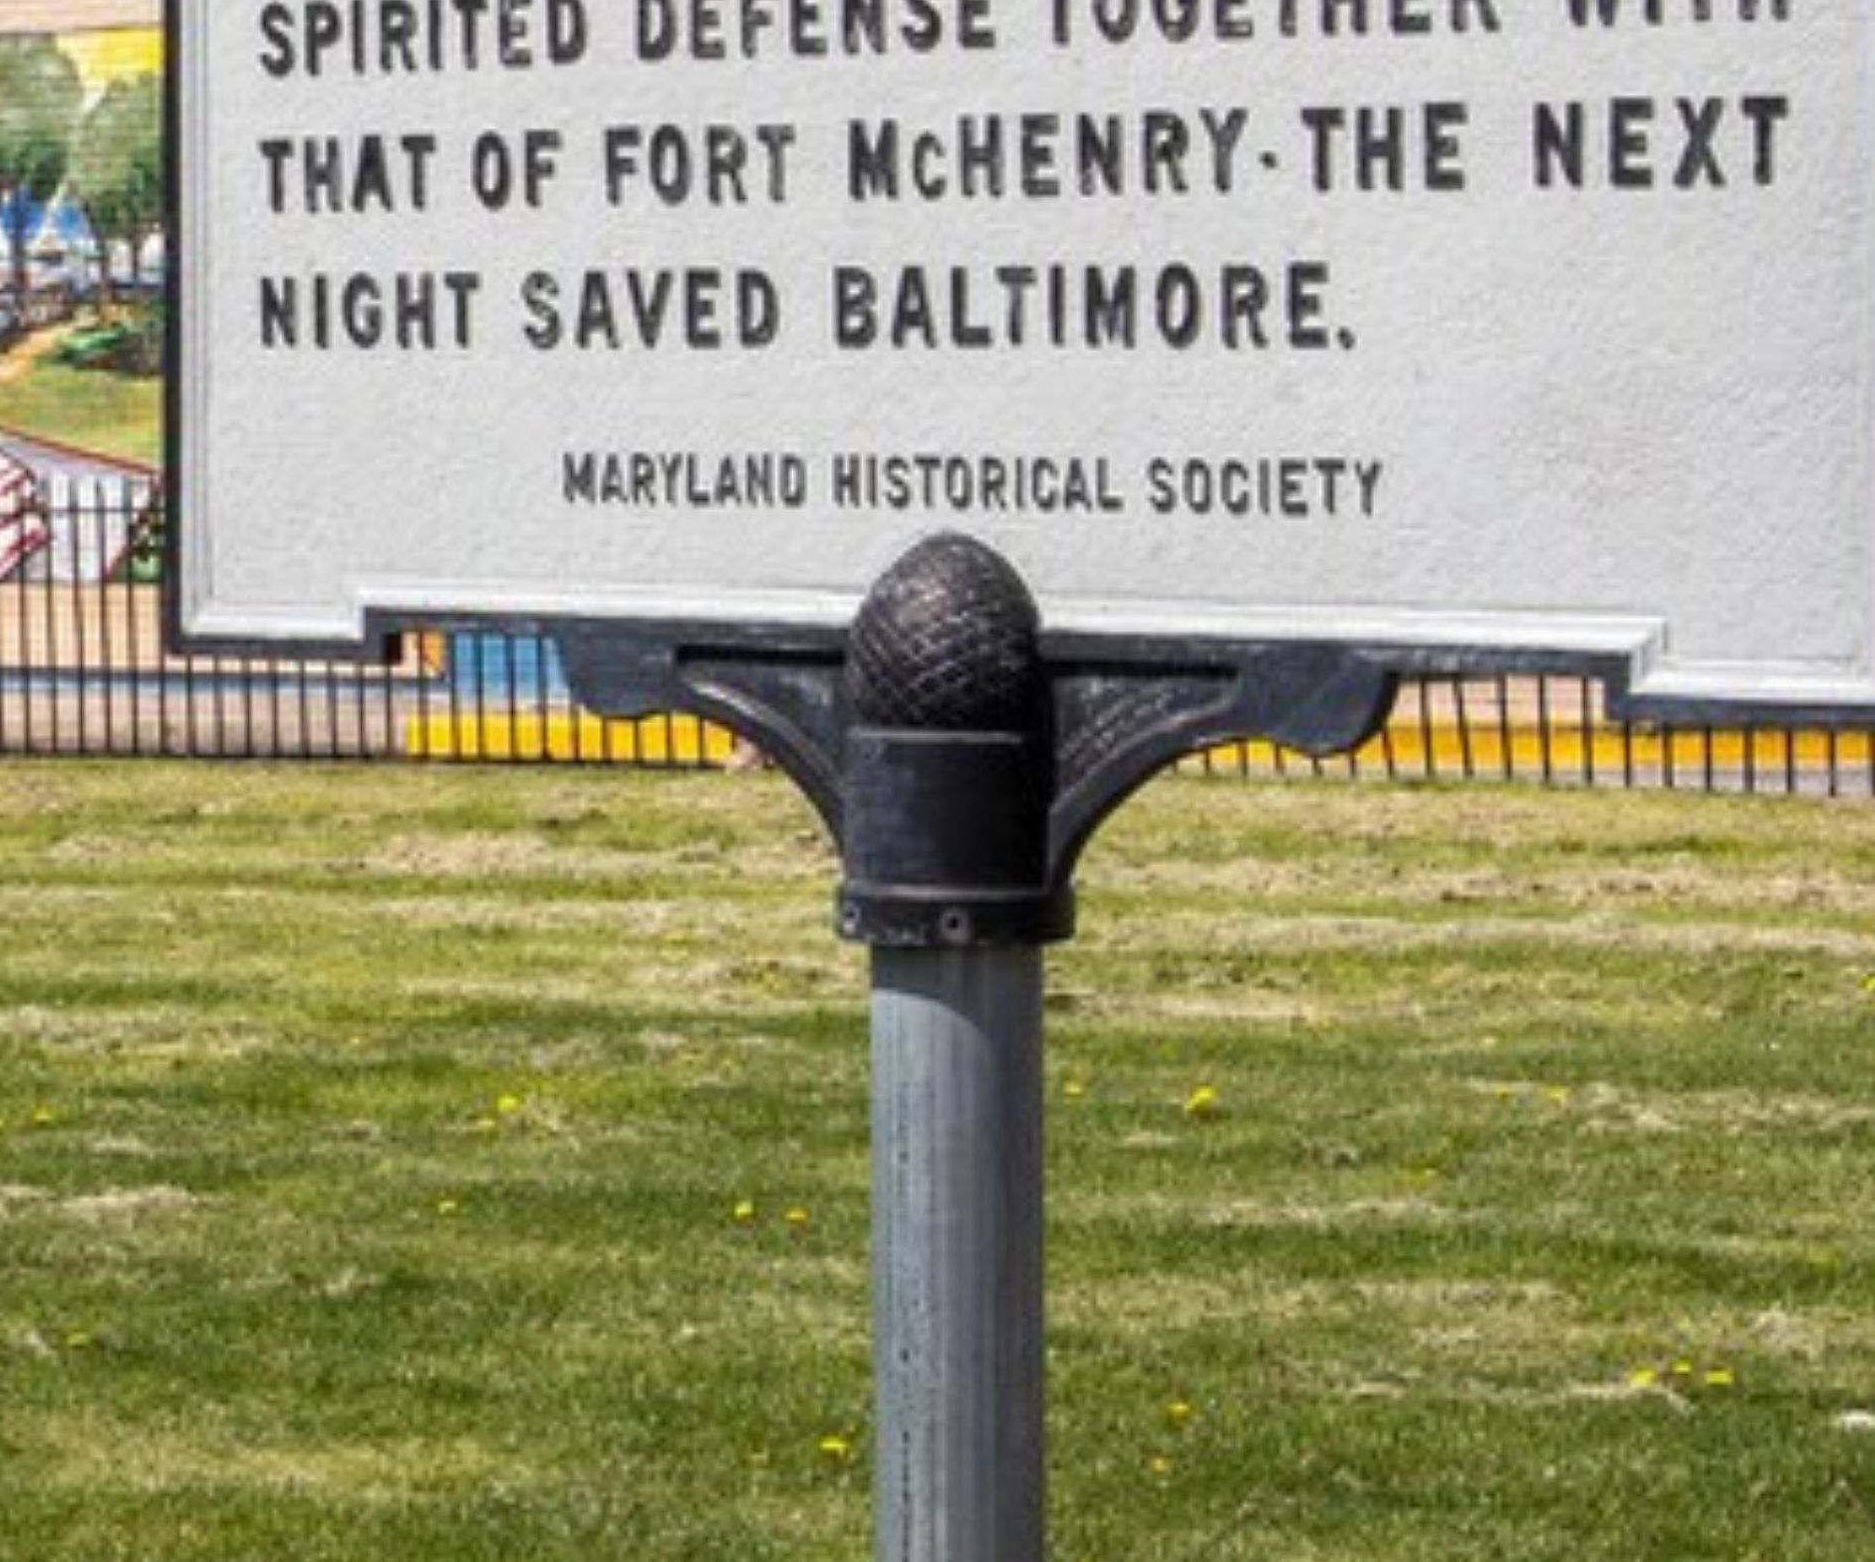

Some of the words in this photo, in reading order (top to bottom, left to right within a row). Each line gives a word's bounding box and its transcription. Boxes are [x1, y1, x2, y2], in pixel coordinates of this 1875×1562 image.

[259, 134, 436, 214] THAT
[472, 129, 561, 211] OF
[604, 123, 796, 206] FORT
[1298, 101, 1468, 193] THE
[1533, 95, 1789, 189] NEXT
[259, 272, 480, 350] NIGHT
[522, 267, 779, 350] SAVED
[563, 452, 806, 508] MARYLAND
[833, 455, 1123, 512] HISTORICAL
[1148, 457, 1382, 517] SOCIETY
